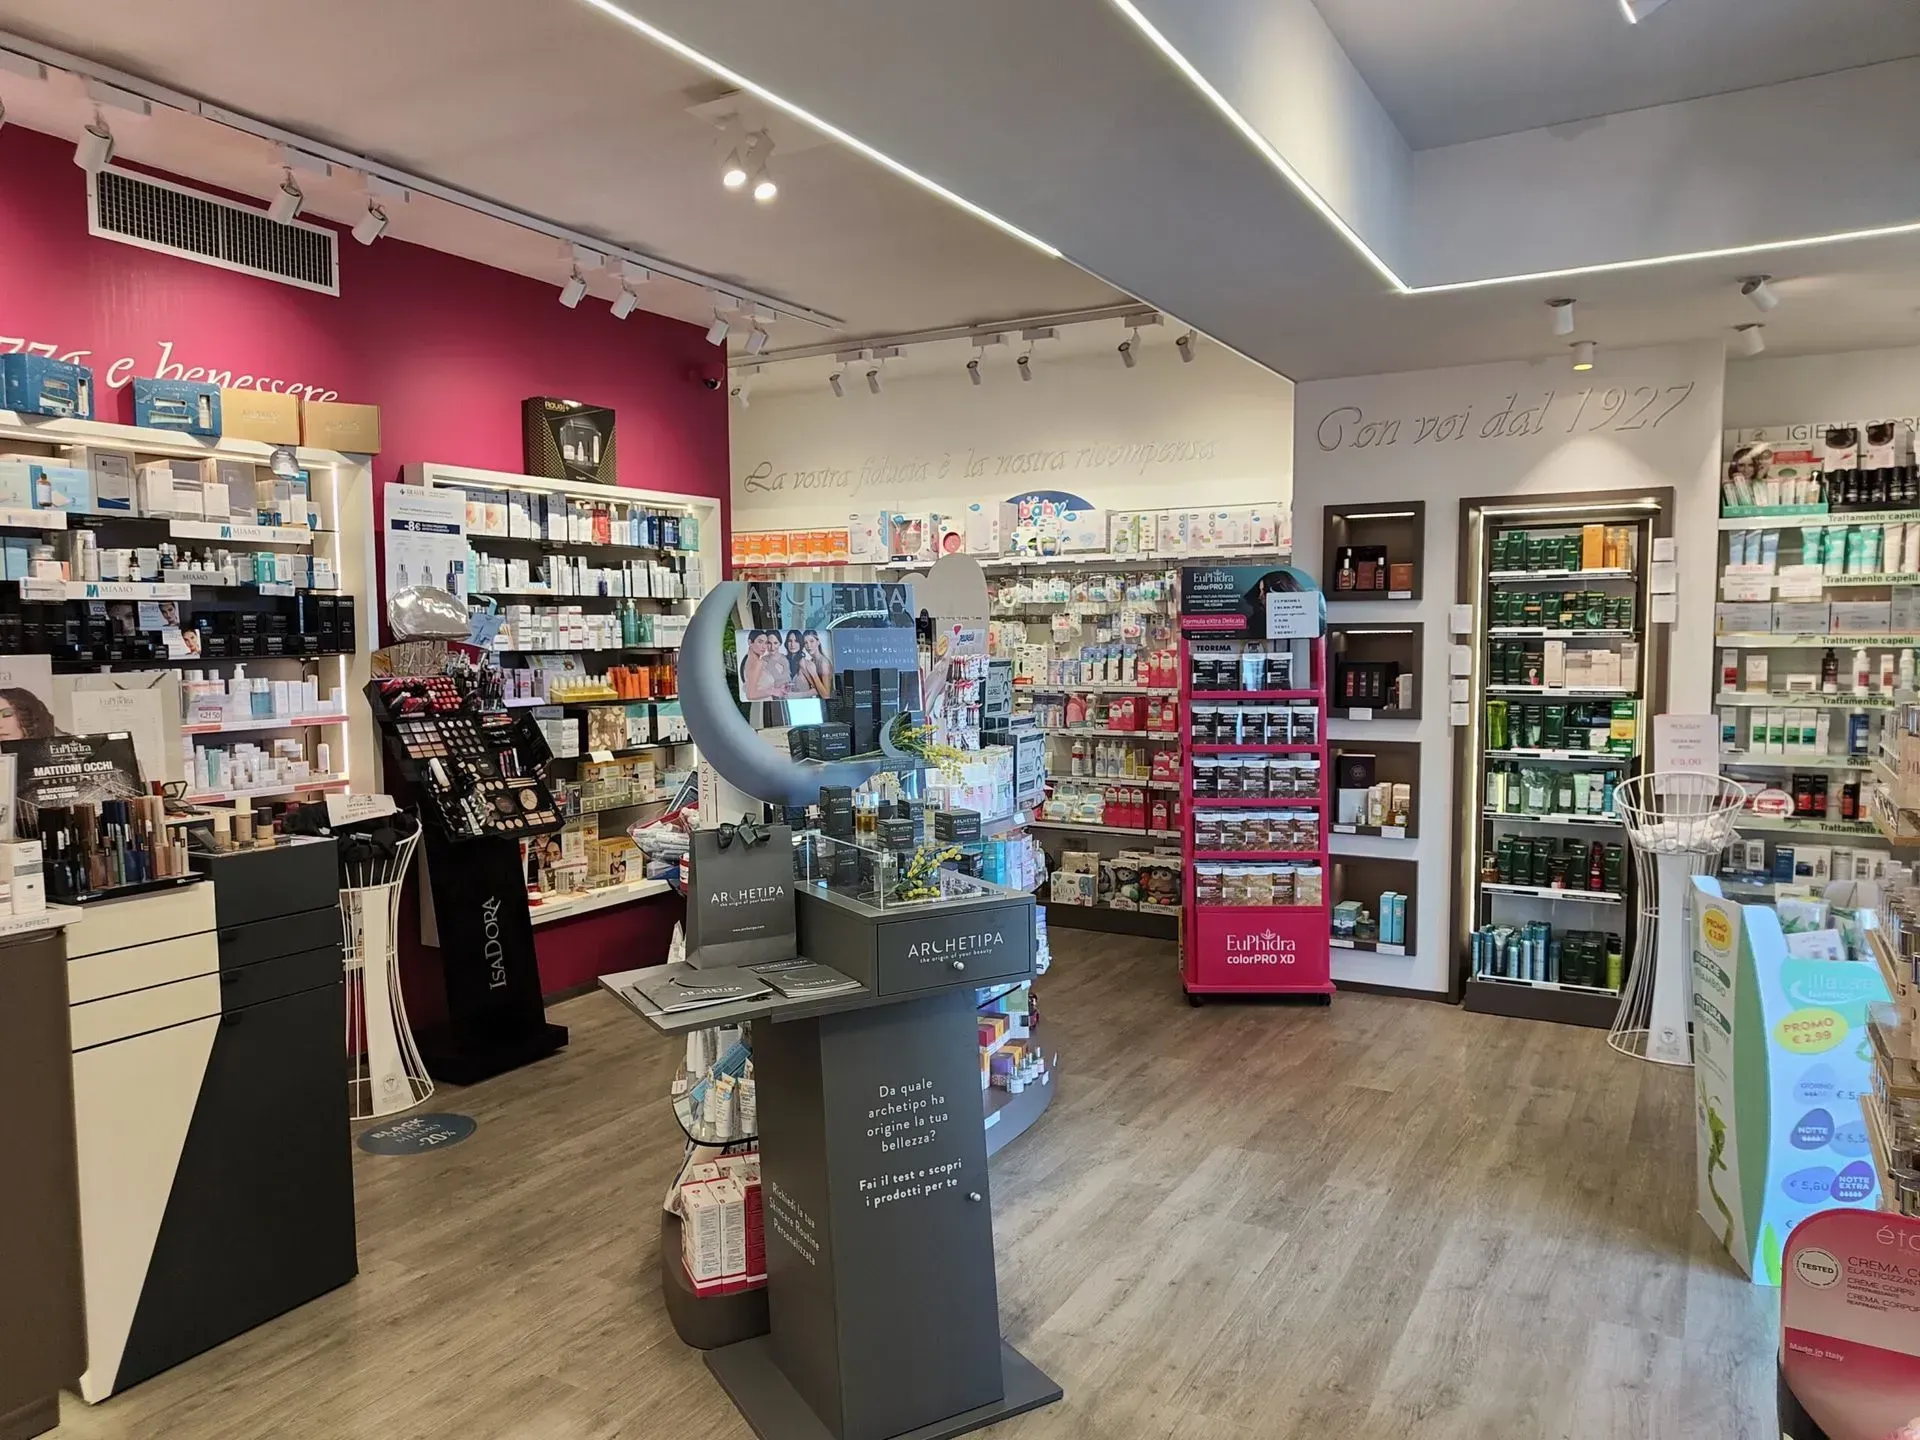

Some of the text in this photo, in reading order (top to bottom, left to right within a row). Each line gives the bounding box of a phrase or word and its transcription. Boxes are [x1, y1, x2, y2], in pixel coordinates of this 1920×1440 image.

[106, 357, 134, 388] e
[1316, 381, 1694, 452] Con voi dal 1927
[744, 460, 787, 493] La
[792, 466, 849, 490] vostra
[963, 447, 990, 479] la
[995, 448, 1066, 476] nostra
[1018, 499, 1067, 519] baby
[1828, 513, 1884, 523] Trattamento
[233, 527, 261, 537] MIAMO
[182, 573, 209, 581] MIAMO
[1193, 571, 1234, 583] EuPhidra
[1825, 573, 1919, 584] Trattamento capelli
[100, 585, 134, 594] MIAMO
[1196, 644, 1232, 652] TEOREMA
[1821, 636, 1914, 646] Trattamento capelli
[1823, 697, 1879, 705] Trattamento
[50, 743, 91, 754] EuPhidra
[34, 761, 114, 777] MATITONI OCCHI
[1819, 823, 1876, 835] Trattamento
[711, 886, 784, 904] ARCHETIPA
[1706, 917, 1728, 933] PROMO
[908, 931, 1004, 958] ARCHETIPA
[1226, 931, 1296, 951] EuPhidra
[932, 954, 949, 962] origin
[959, 951, 972, 959] your
[973, 948, 993, 956] beauty
[1227, 954, 1296, 964] colorPRO XD
[1783, 1017, 1834, 1033] PROMO
[1792, 1030, 1832, 1044] € 2,99
[879, 1078, 933, 1098] Da quale
[868, 1093, 945, 1119] archetipo ha
[371, 1118, 425, 1139] BLACK
[867, 1113, 948, 1138] origine la tua
[1798, 1127, 1829, 1135] NOTTE
[881, 1129, 936, 1153] bellezza?
[859, 1158, 962, 1191] Fai il test e scopri
[1840, 1176, 1870, 1184] NOTTE
[866, 1178, 958, 1209] i prodotti per te
[1801, 1180, 1830, 1192] 5,60
[804, 1212, 815, 1229] tua
[1801, 1262, 1835, 1275] TESTED
[1847, 1256, 1901, 1275] CREMA
[1825, 1349, 1844, 1362] Italy
